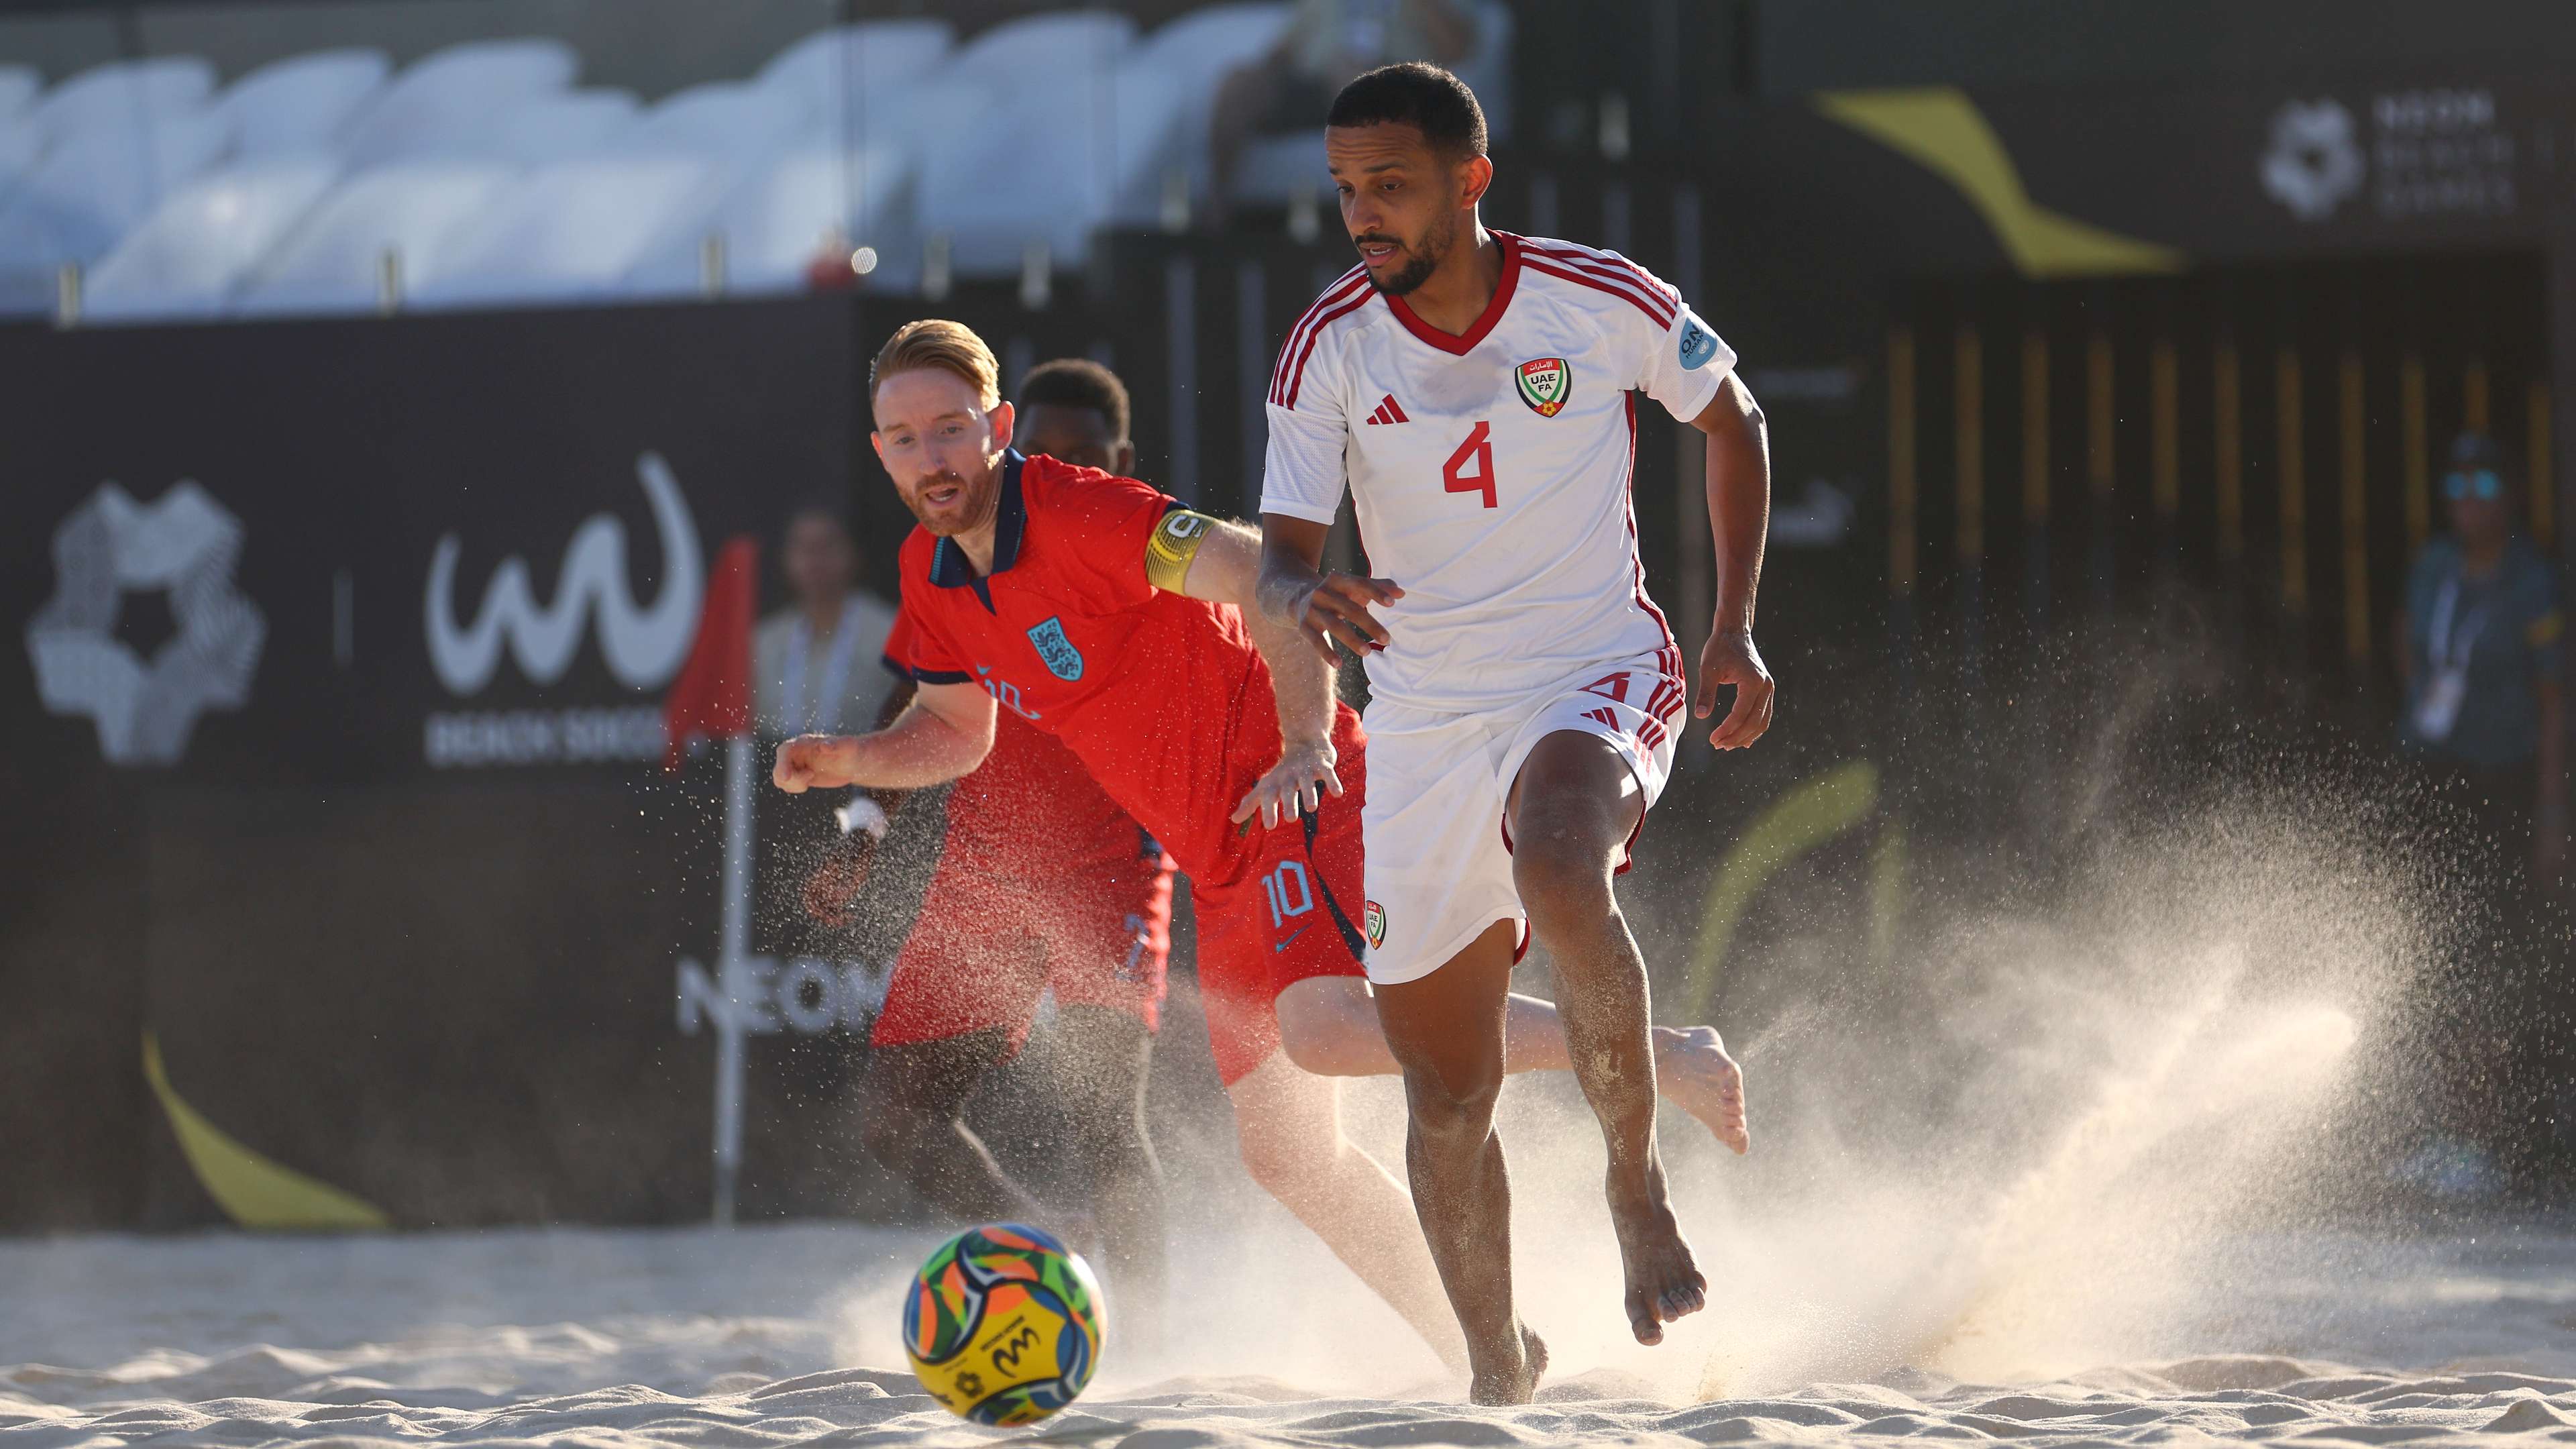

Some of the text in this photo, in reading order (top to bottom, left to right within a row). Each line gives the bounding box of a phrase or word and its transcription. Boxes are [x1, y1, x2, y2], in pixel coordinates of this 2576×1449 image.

[1530, 374, 1556, 384] UAE
[1443, 421, 1497, 508] 4
[426, 711, 553, 767] BEACH
[1260, 861, 1313, 928] 10
